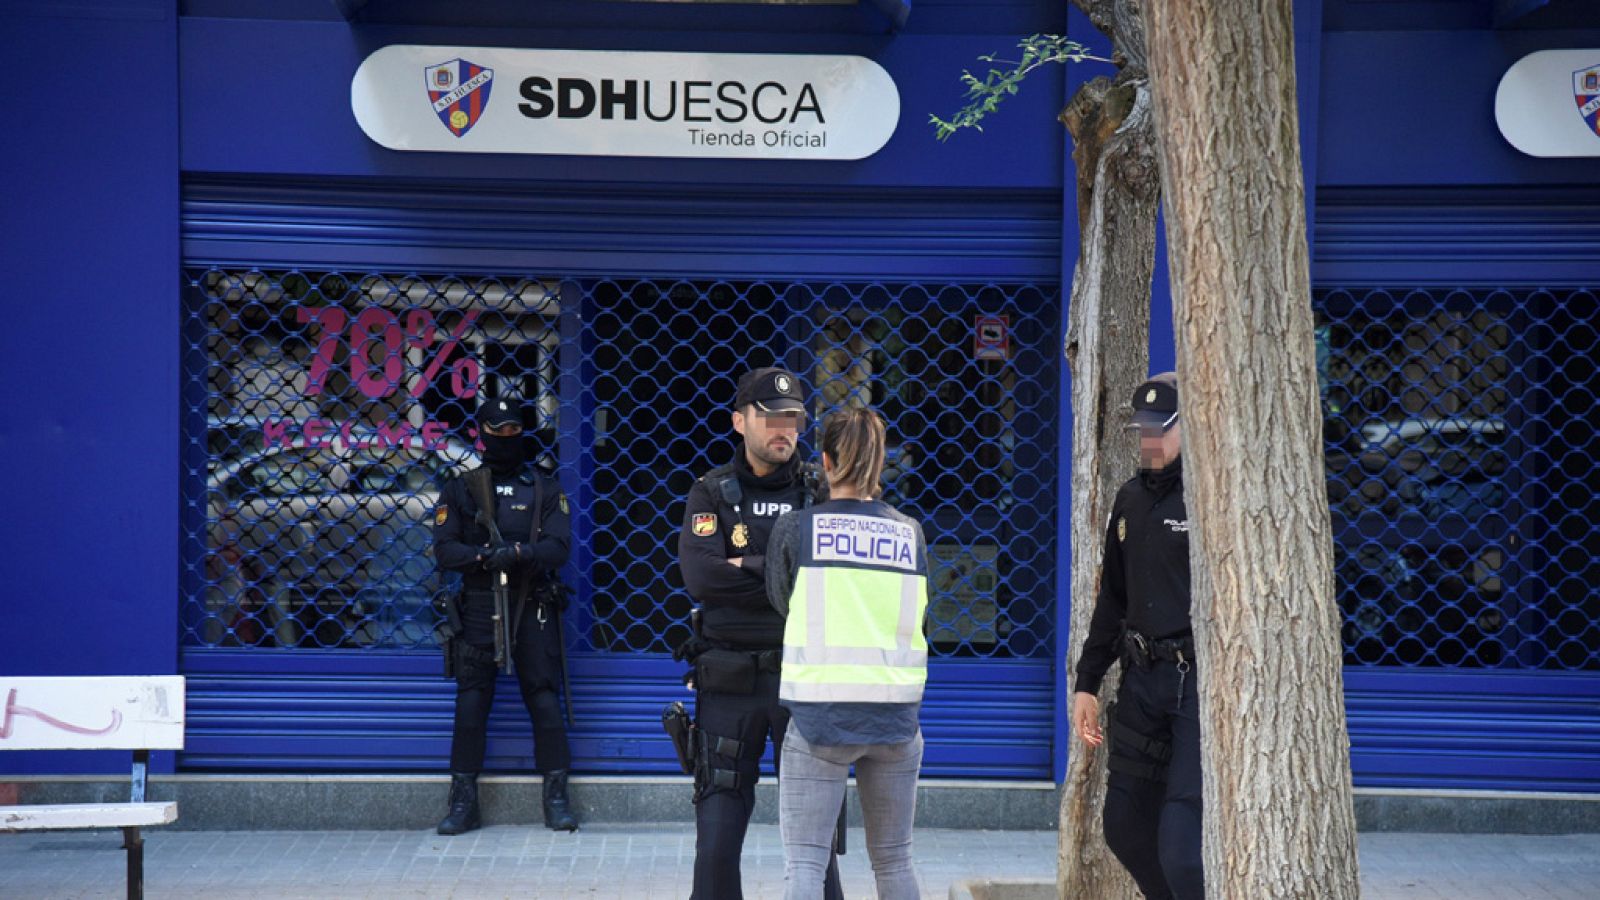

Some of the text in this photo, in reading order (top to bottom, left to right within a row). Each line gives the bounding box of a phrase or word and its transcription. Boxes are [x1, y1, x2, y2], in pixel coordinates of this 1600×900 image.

[687, 128, 827, 148] Tienda Oficial
[297, 308, 480, 398] 70%
[263, 420, 450, 450] KELME
[496, 485, 514, 496] PR
[816, 518, 913, 540] CUERPO NACIONAL DE
[816, 533, 912, 564] POLICIA
